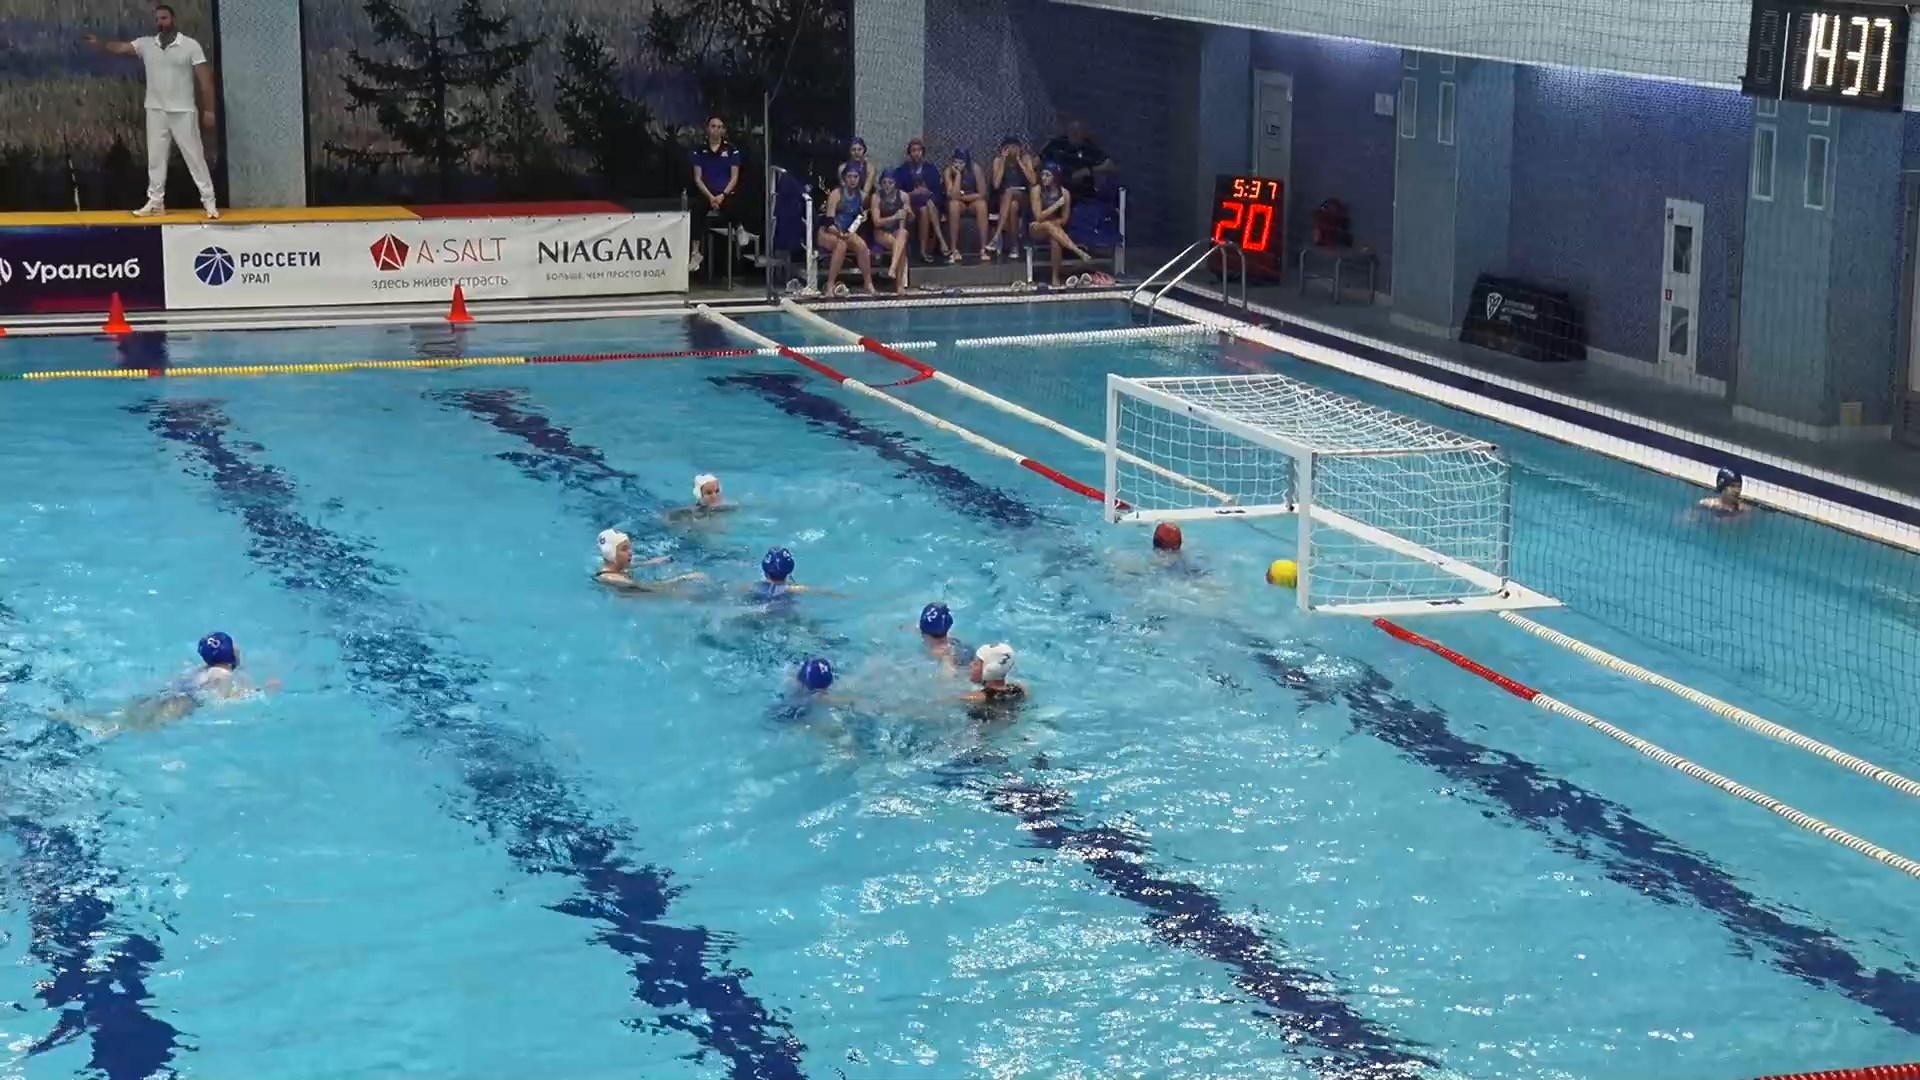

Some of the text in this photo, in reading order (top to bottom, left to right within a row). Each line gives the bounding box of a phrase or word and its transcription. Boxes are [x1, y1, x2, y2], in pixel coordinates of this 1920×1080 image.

[1232, 178, 1278, 200] 5:37
[1214, 201, 1273, 251] 20
[240, 252, 321, 268] РОССЕТИ
[538, 237, 673, 264] NIAGARA
[22, 257, 141, 283] Уралсиб
[241, 273, 271, 284] УРАЛ
[371, 275, 509, 290] здесь живет страсть
